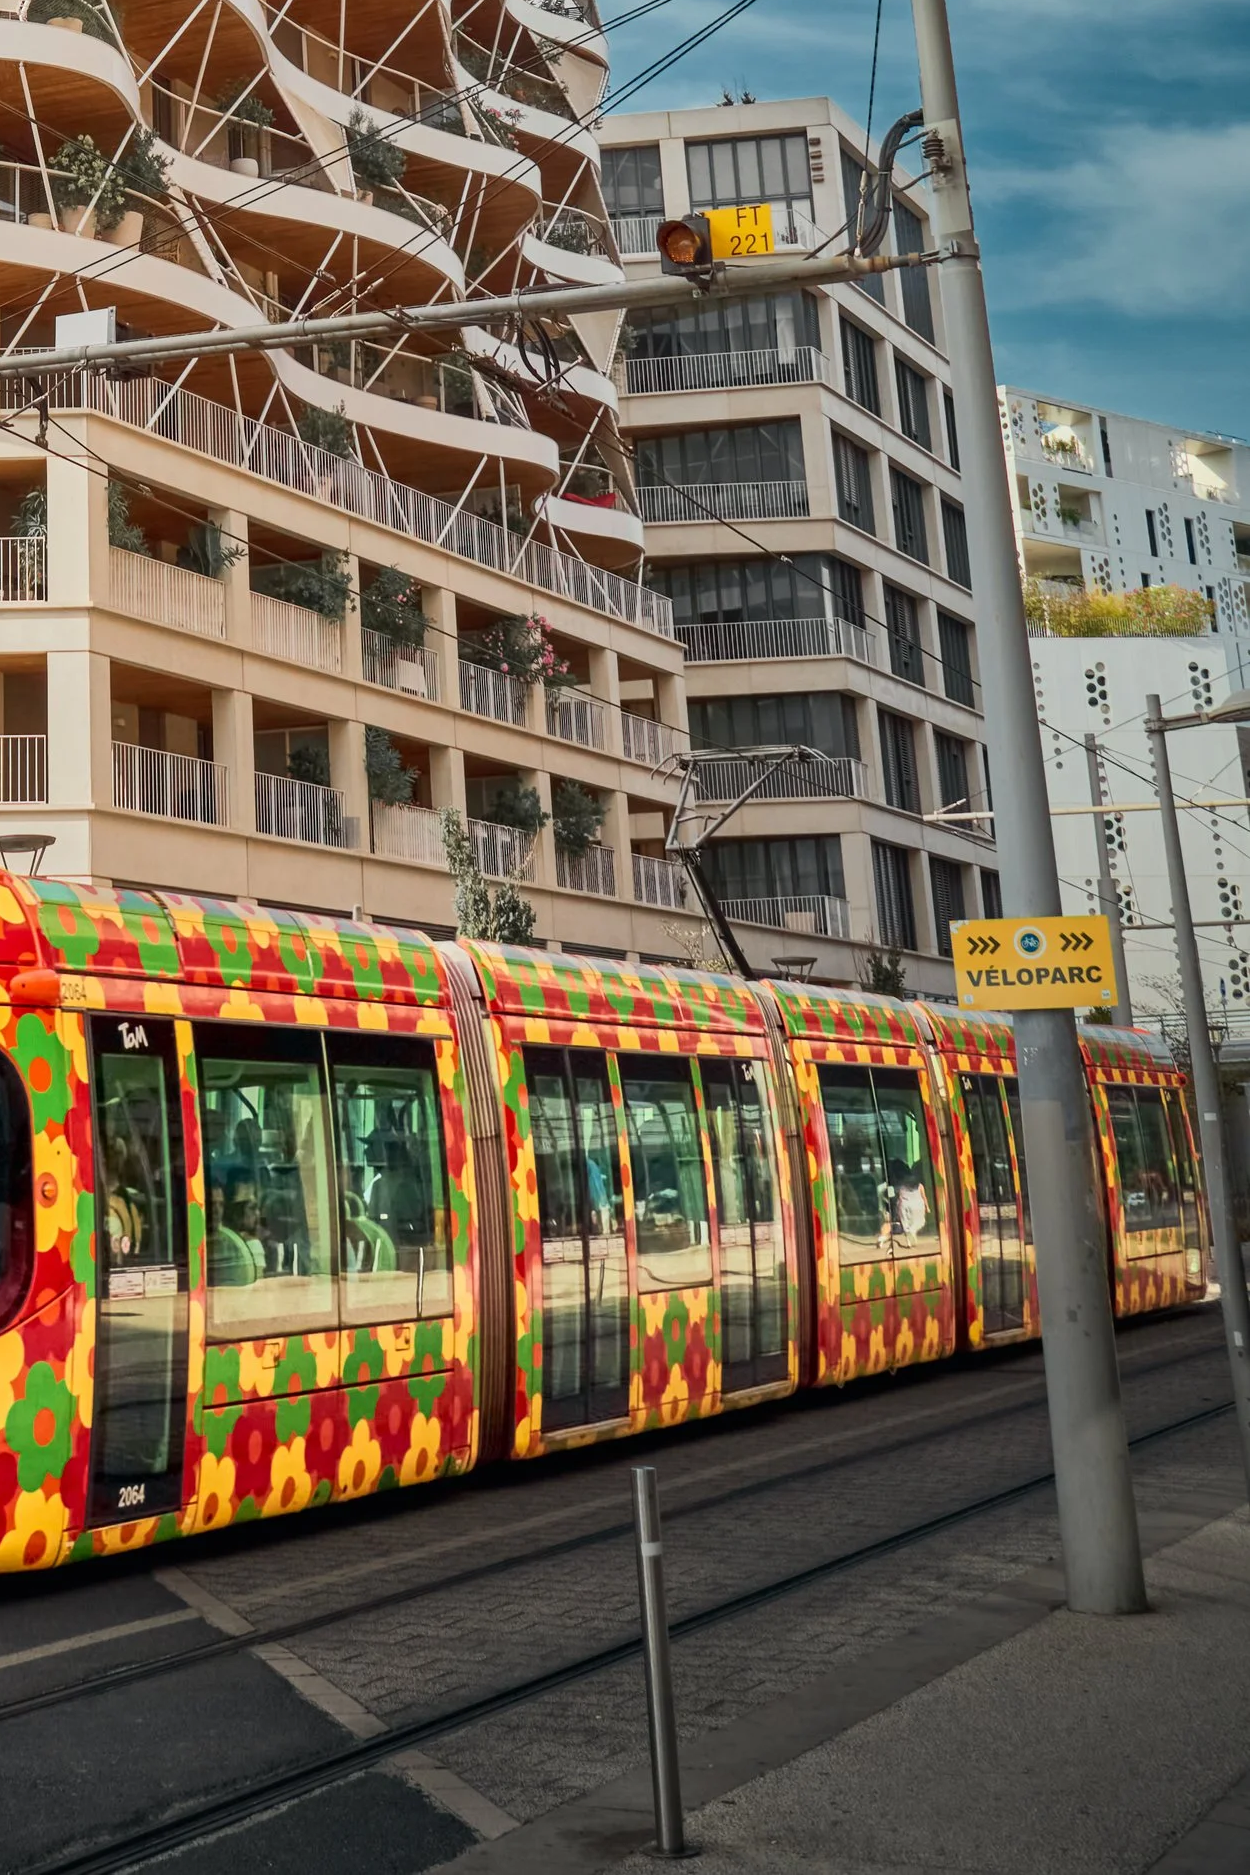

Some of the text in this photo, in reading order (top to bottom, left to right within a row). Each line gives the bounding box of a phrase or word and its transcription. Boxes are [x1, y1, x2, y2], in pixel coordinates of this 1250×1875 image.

[736, 205, 761, 227] FT
[730, 232, 769, 255] 221
[966, 965, 1103, 987] VÉLOPARC
[61, 981, 87, 1001] 2064
[118, 1483, 145, 1507] 2064
